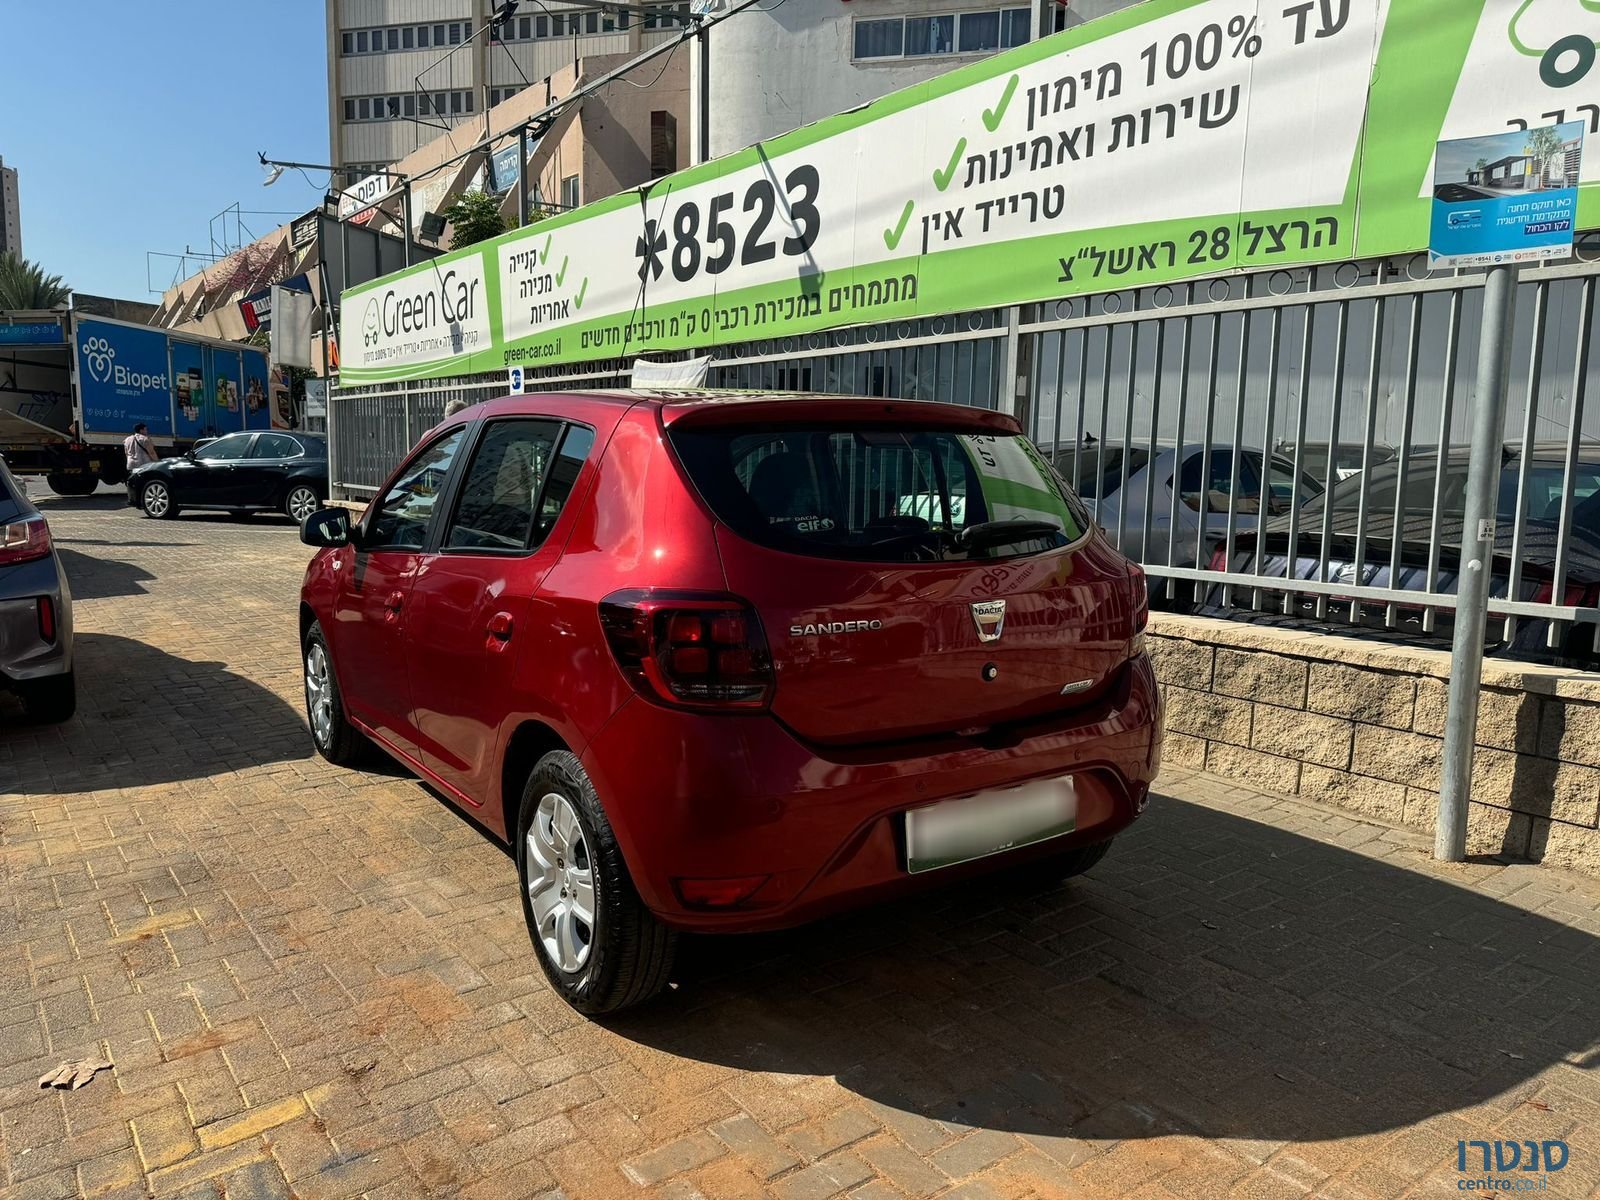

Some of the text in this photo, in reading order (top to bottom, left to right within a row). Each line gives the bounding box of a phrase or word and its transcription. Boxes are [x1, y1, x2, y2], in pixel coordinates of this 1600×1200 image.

[1027, 0, 1350, 131] עד 100% מימון
[963, 84, 1240, 189] שירות ואמינות
[358, 176, 381, 201] דפוס
[1496, 210, 1570, 225] מתקדמת וחדשנית
[1507, 198, 1572, 213] כאן תוקם תחנה
[921, 183, 1065, 254] טרייד אין
[1526, 220, 1569, 233] לקו הכחול
[1188, 226, 1230, 264] 28
[1242, 216, 1338, 256] הרצל
[509, 249, 537, 274] קנייה
[520, 273, 552, 298] מכירה
[829, 274, 917, 312] מתמחים
[383, 270, 478, 337] Green Car
[530, 299, 569, 324] אחריות
[754, 292, 822, 325] במכירת
[701, 308, 710, 333] 0
[715, 305, 749, 330] רכבי
[581, 326, 620, 348] חדשים
[624, 319, 665, 342] ורכבים
[504, 338, 561, 365] green-car.co.il
[114, 365, 167, 392] Biopet
[797, 520, 820, 531] elf
[978, 606, 1003, 615] DACIA
[790, 620, 882, 636] SANDERO
